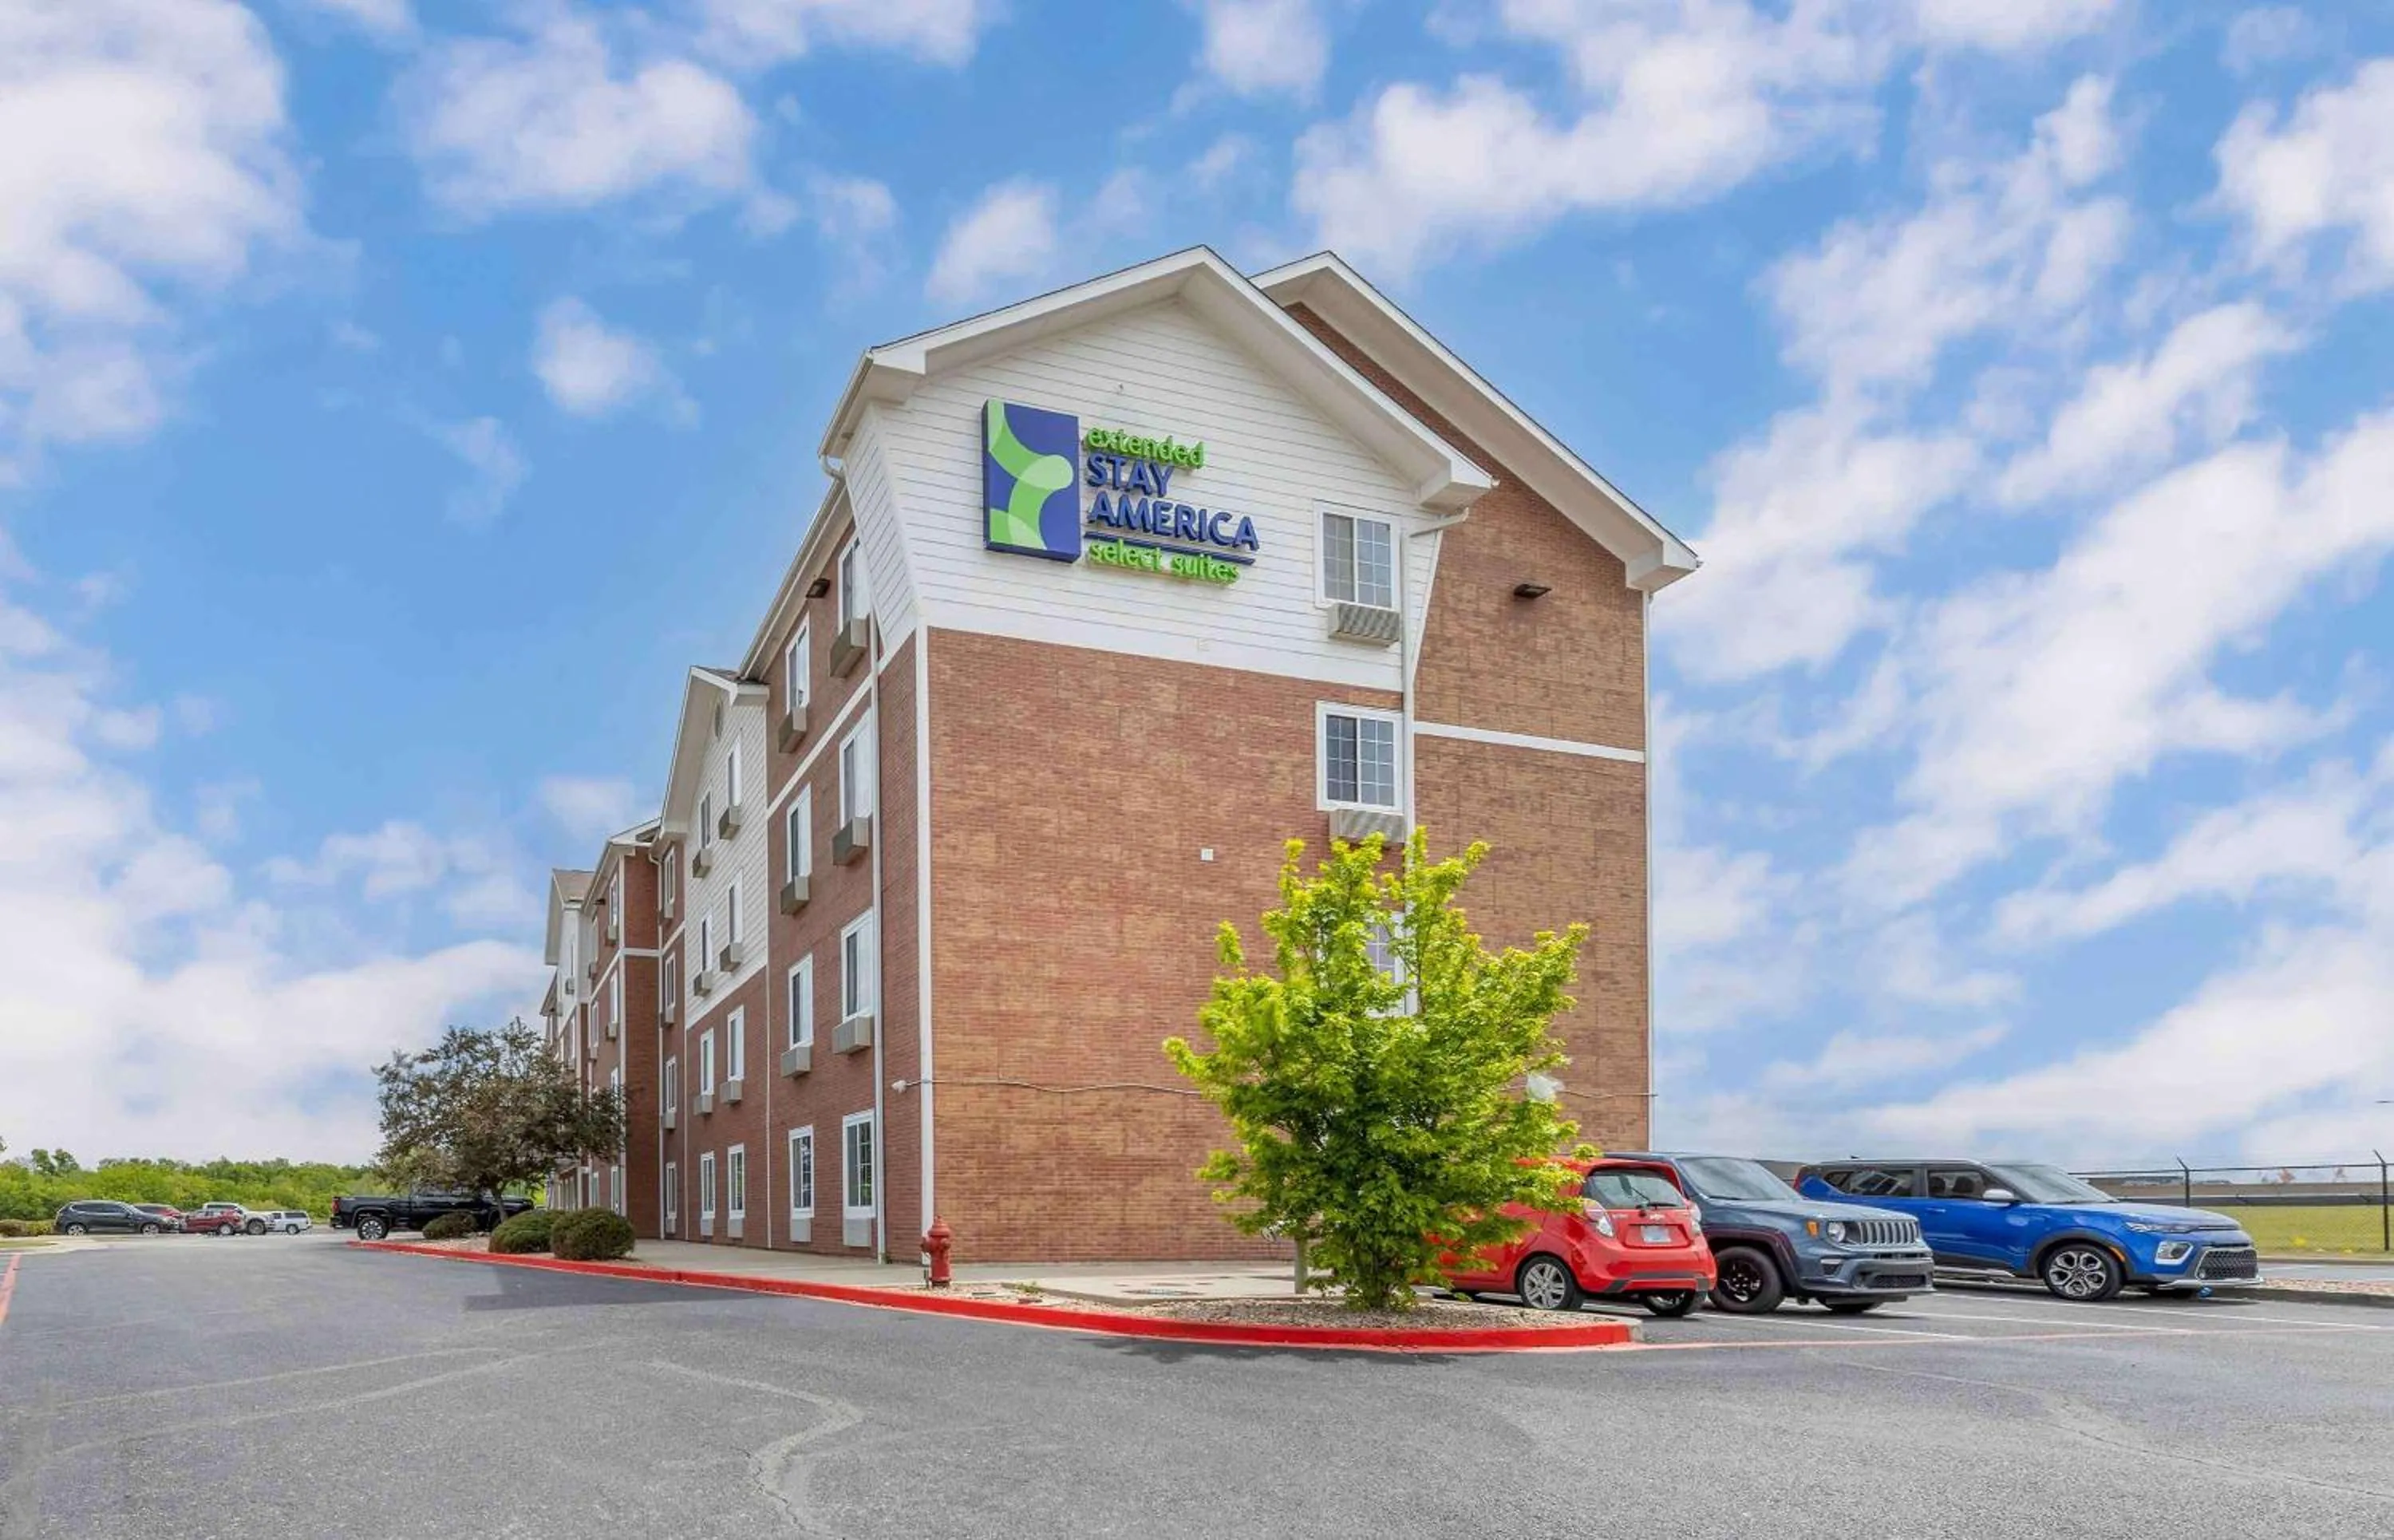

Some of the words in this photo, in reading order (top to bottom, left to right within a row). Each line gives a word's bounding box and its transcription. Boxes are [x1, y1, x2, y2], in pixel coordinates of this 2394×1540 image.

[1085, 428, 1205, 468] extended
[1087, 452, 1175, 497] STAY
[1087, 491, 1259, 551] AMERICA
[1088, 539, 1161, 573] select
[1170, 555, 1239, 585] suites
